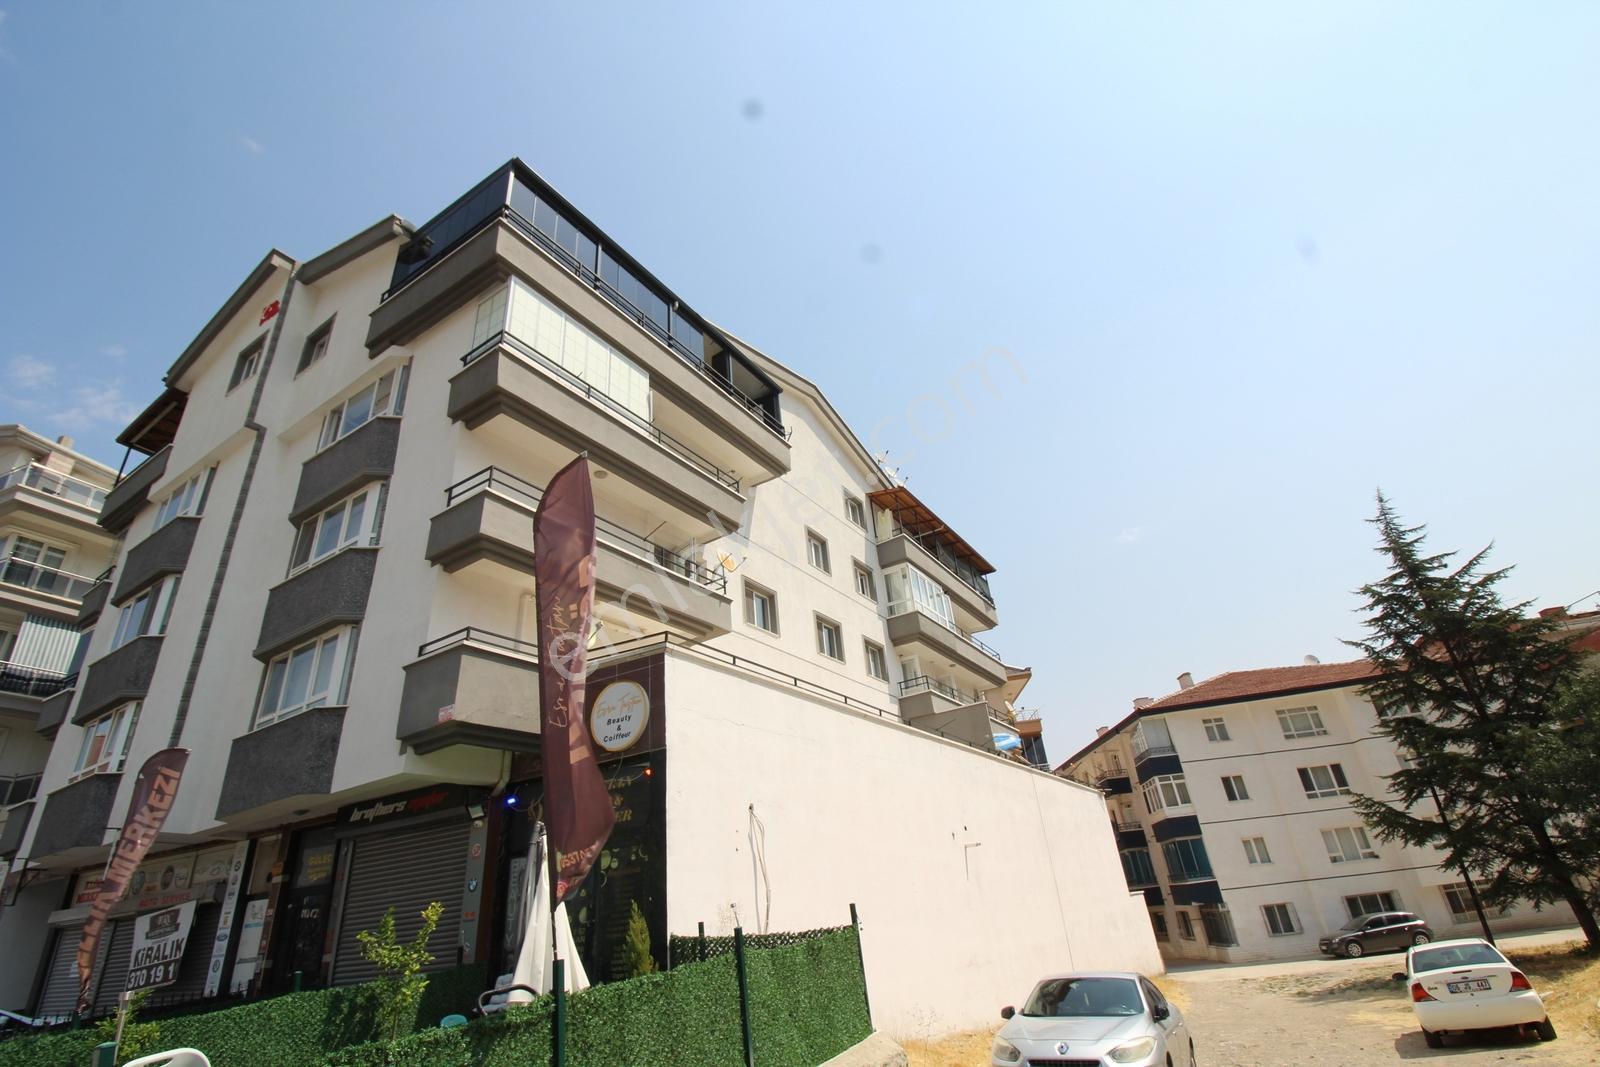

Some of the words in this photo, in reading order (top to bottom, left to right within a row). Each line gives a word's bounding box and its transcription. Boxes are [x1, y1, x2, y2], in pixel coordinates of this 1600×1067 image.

[606, 714, 632, 726] Beauty
[603, 731, 632, 743] Coiffeur
[133, 938, 184, 968] KİRALIK
[128, 969, 148, 989] 370
[150, 965, 165, 984] 19
